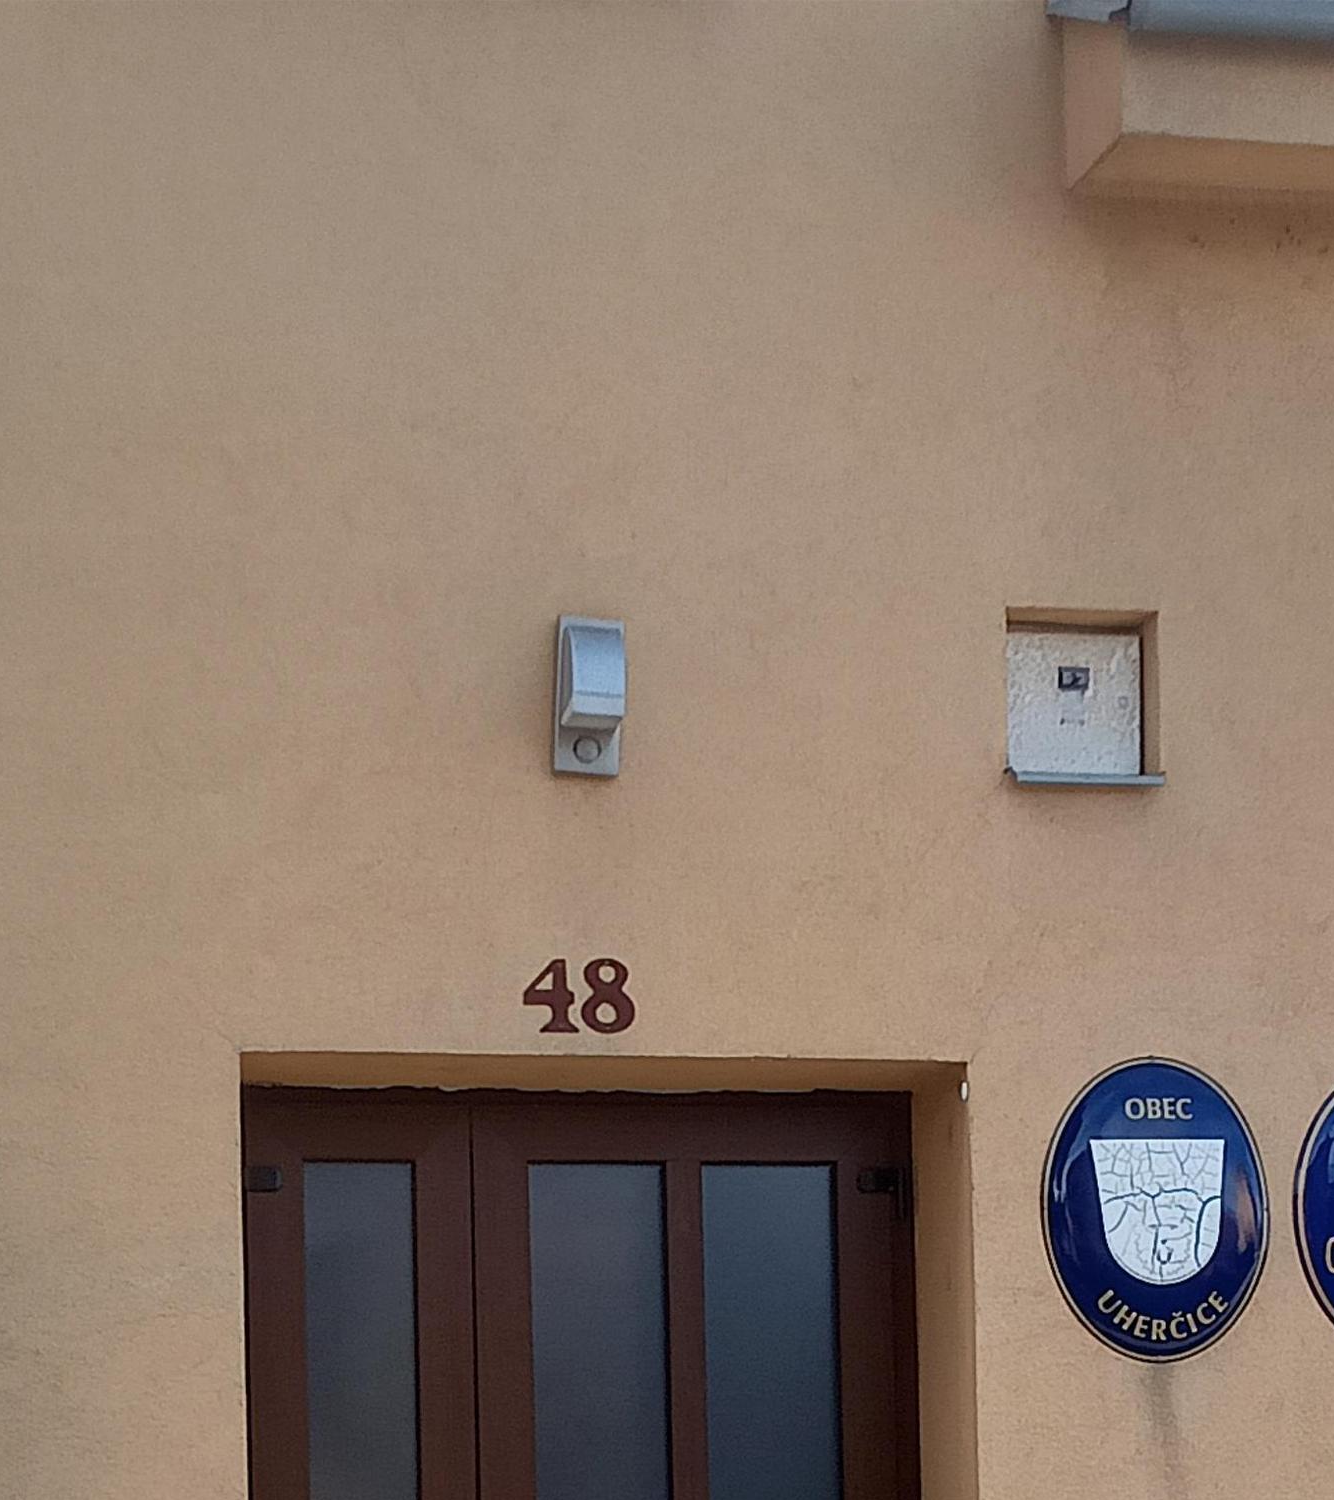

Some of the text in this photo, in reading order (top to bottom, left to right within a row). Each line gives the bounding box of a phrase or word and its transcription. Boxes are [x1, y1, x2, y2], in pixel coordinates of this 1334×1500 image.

[523, 958, 636, 1034] 48
[1124, 1097, 1194, 1121] OBEC
[1096, 1289, 1231, 1341] UHERČICE
